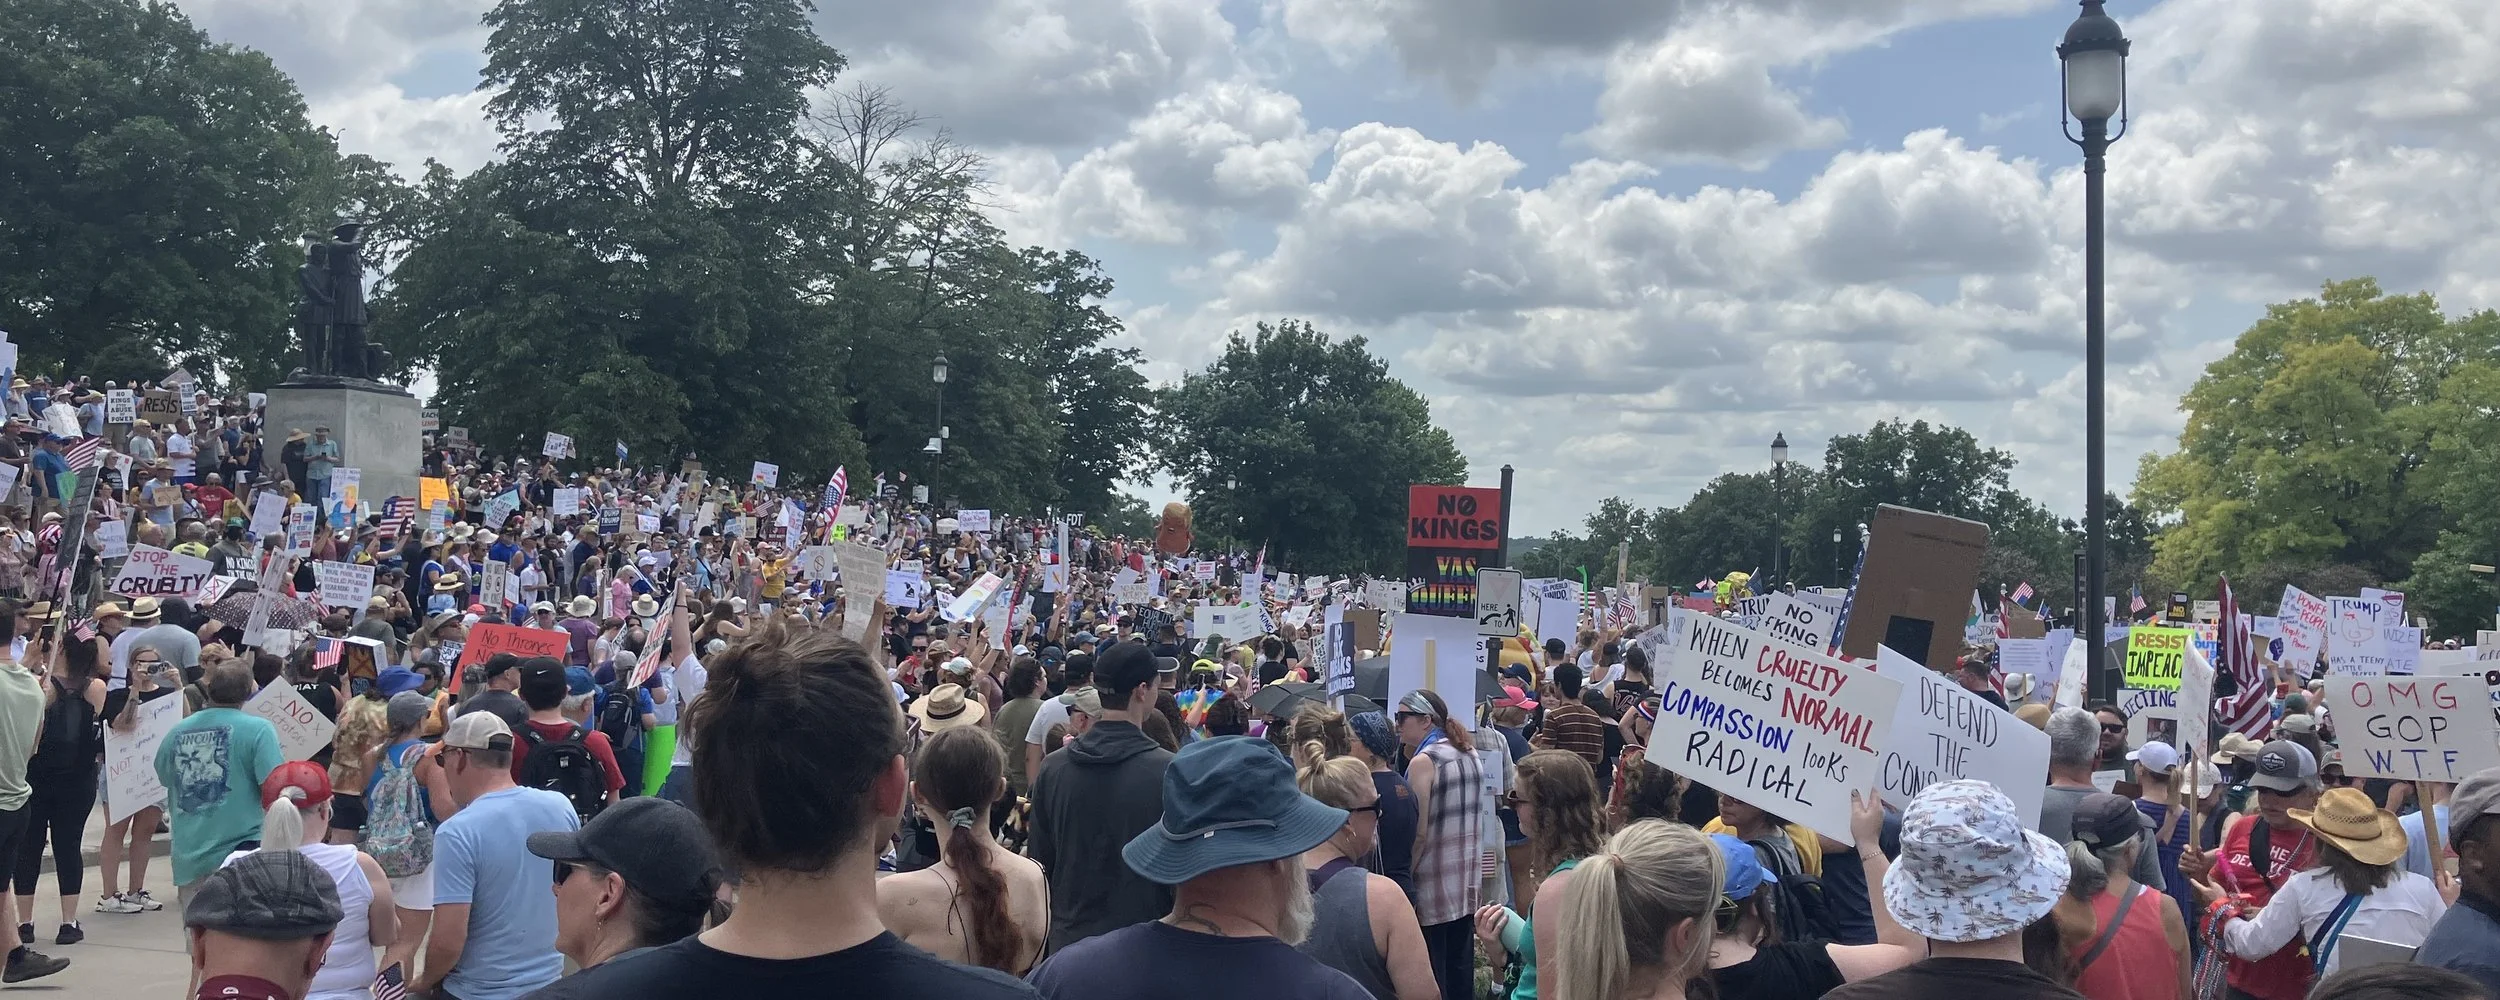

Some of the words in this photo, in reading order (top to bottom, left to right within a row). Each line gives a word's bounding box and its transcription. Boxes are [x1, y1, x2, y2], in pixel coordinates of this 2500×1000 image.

[603, 509, 620, 517] DUMP
[1437, 494, 1477, 516] NO
[1067, 513, 1083, 526] FDT
[1411, 517, 1497, 541] KINGS
[132, 551, 169, 563] STOP
[225, 556, 235, 569] NO
[153, 563, 179, 576] THE
[1436, 556, 1477, 583] YAS
[118, 573, 206, 595] CRUELTY
[1549, 583, 1568, 592] PUEBLO
[1139, 607, 1174, 624] EQUALITY
[1785, 604, 1813, 625] NO
[2173, 606, 2184, 614] NO
[2331, 600, 2381, 622] TRUMP
[1143, 619, 1159, 630] HUR
[1494, 620, 1502, 628] TO
[481, 628, 499, 646] No
[507, 633, 554, 655] Thrones
[2291, 637, 2311, 651] Power
[1690, 620, 1749, 660] WHEN
[1757, 645, 1848, 697] CRUELTY
[2127, 650, 2182, 679] IMPEAC
[2331, 656, 2346, 664] HAS
[2360, 656, 2384, 664] TEENY
[153, 699, 175, 720] peak
[283, 700, 313, 724] NO
[1701, 660, 1773, 702] BECOMES
[1781, 687, 1879, 757] NORMAL,
[1921, 676, 1998, 748] DEFEND
[2122, 690, 2178, 719] JECTING
[1663, 681, 1793, 753] COMPASSION
[1928, 732, 1971, 780] THE
[110, 756, 133, 780] NOT
[1686, 731, 1812, 807] RADICAL
